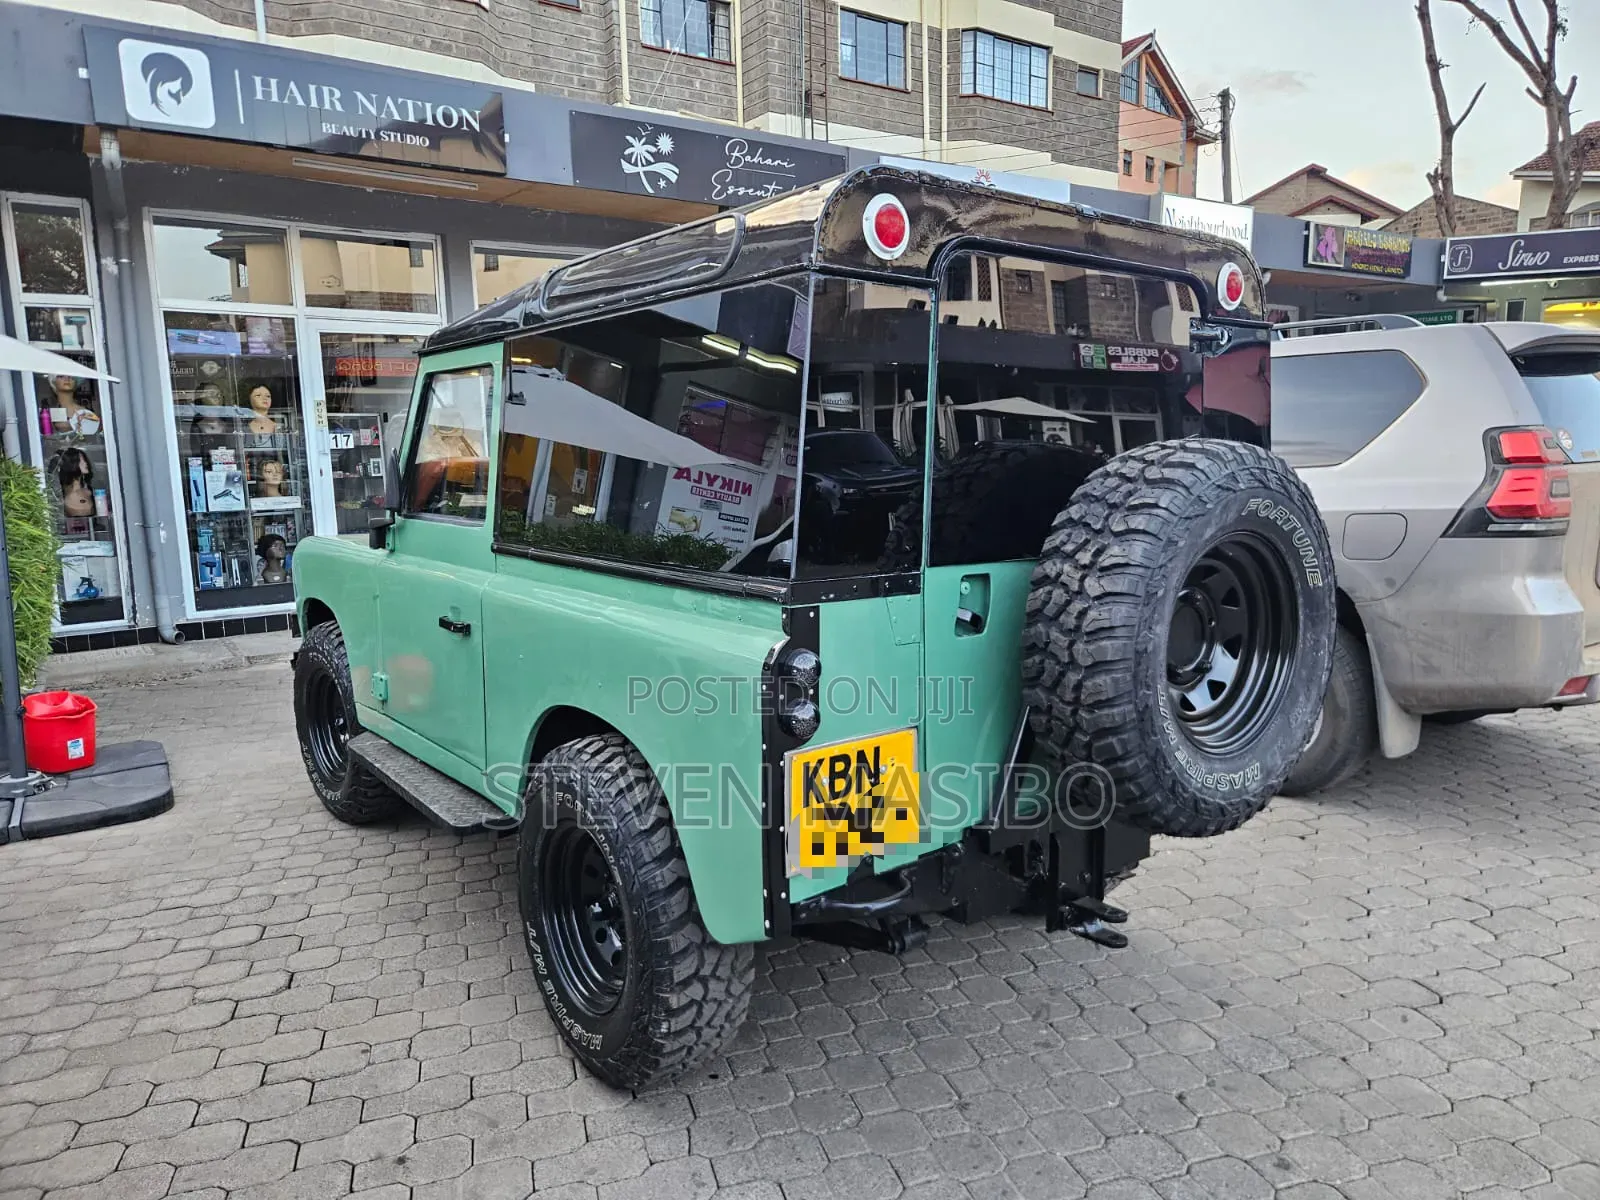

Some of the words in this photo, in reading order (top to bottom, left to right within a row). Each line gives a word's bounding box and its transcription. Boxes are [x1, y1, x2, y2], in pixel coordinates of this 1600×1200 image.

[252, 75, 345, 113] HAIR
[353, 90, 481, 133] NATION
[322, 122, 376, 141] BEAUTY
[380, 130, 430, 147] STUDIO
[725, 138, 796, 169] Bahari
[1563, 254, 1599, 264] EXPRESS
[316, 401, 325, 425] PUSH
[332, 434, 352, 449] 17
[1241, 498, 1322, 587] FORTUNE
[802, 745, 881, 808] KBN
[1174, 747, 1261, 791] MASPIRE
